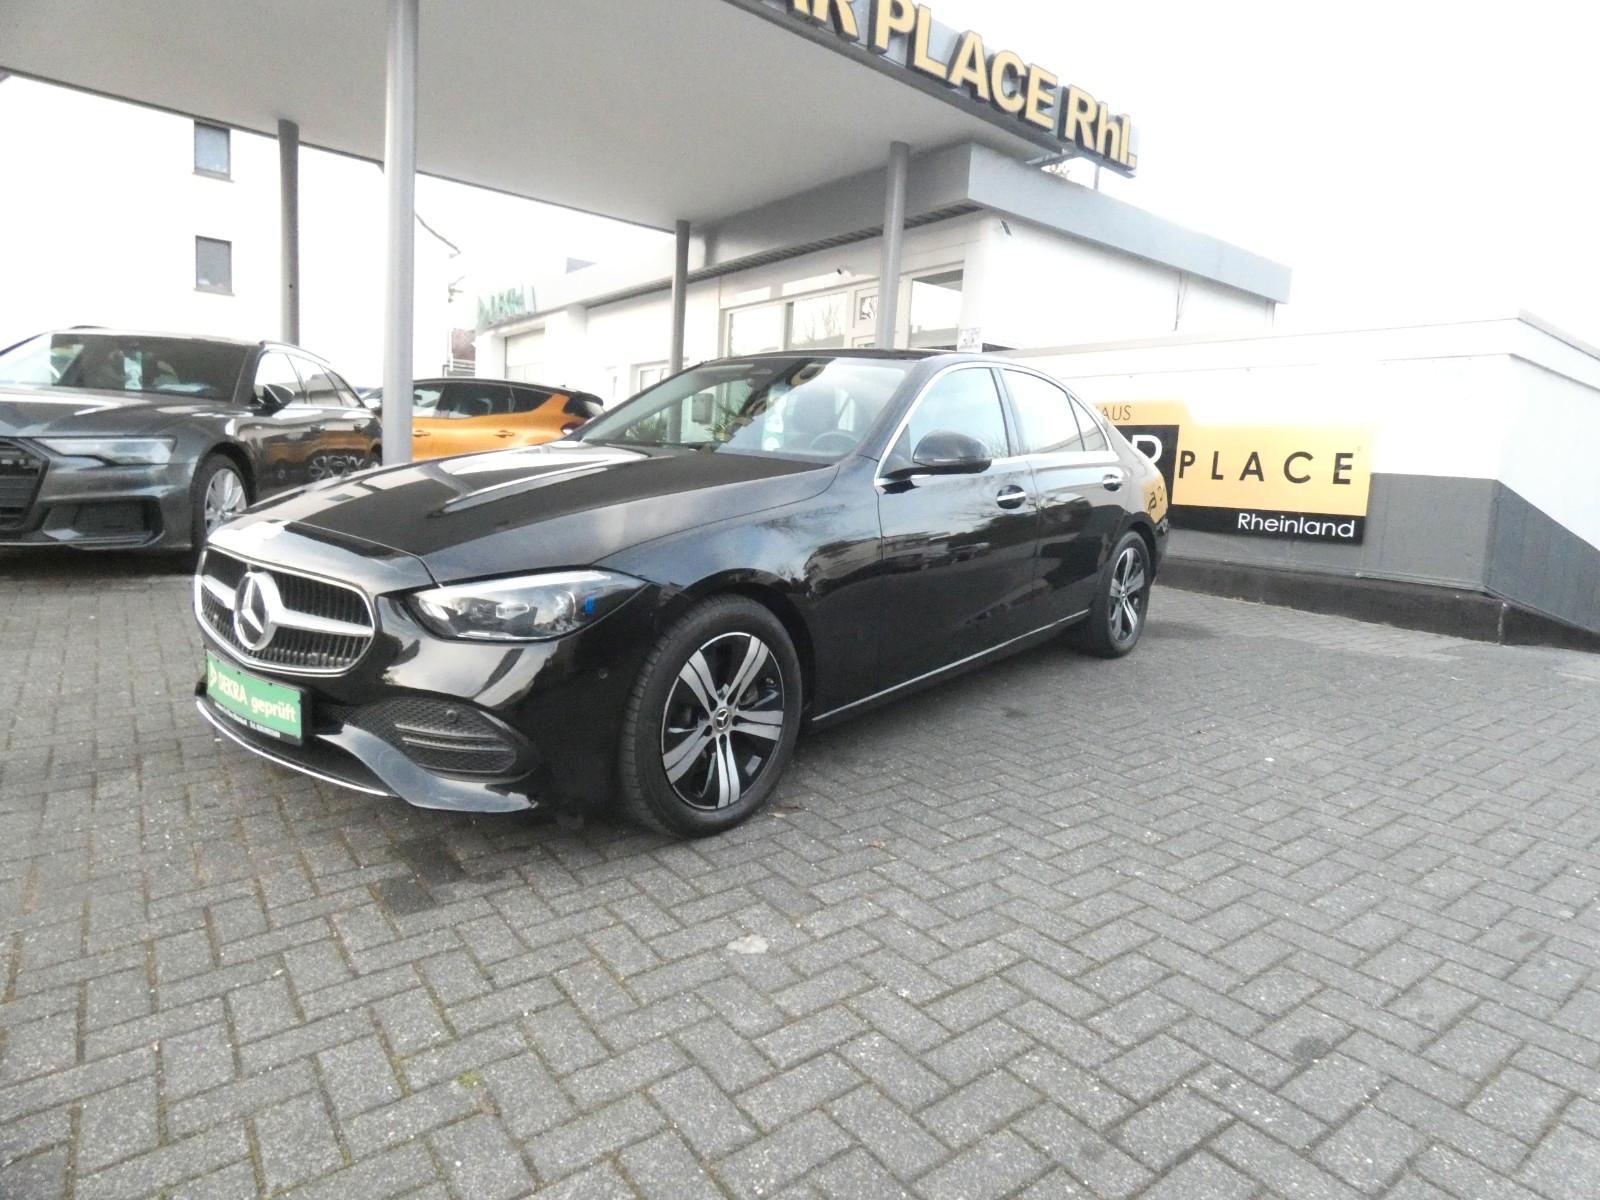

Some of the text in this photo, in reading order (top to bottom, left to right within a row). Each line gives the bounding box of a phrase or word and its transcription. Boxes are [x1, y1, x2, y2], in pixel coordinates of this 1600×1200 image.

[873, 0, 1058, 129] PLACE
[1097, 404, 1132, 421] AUS
[1178, 450, 1354, 485] PLACE
[1237, 512, 1355, 538] Rheinland
[250, 696, 297, 723] geprüft
